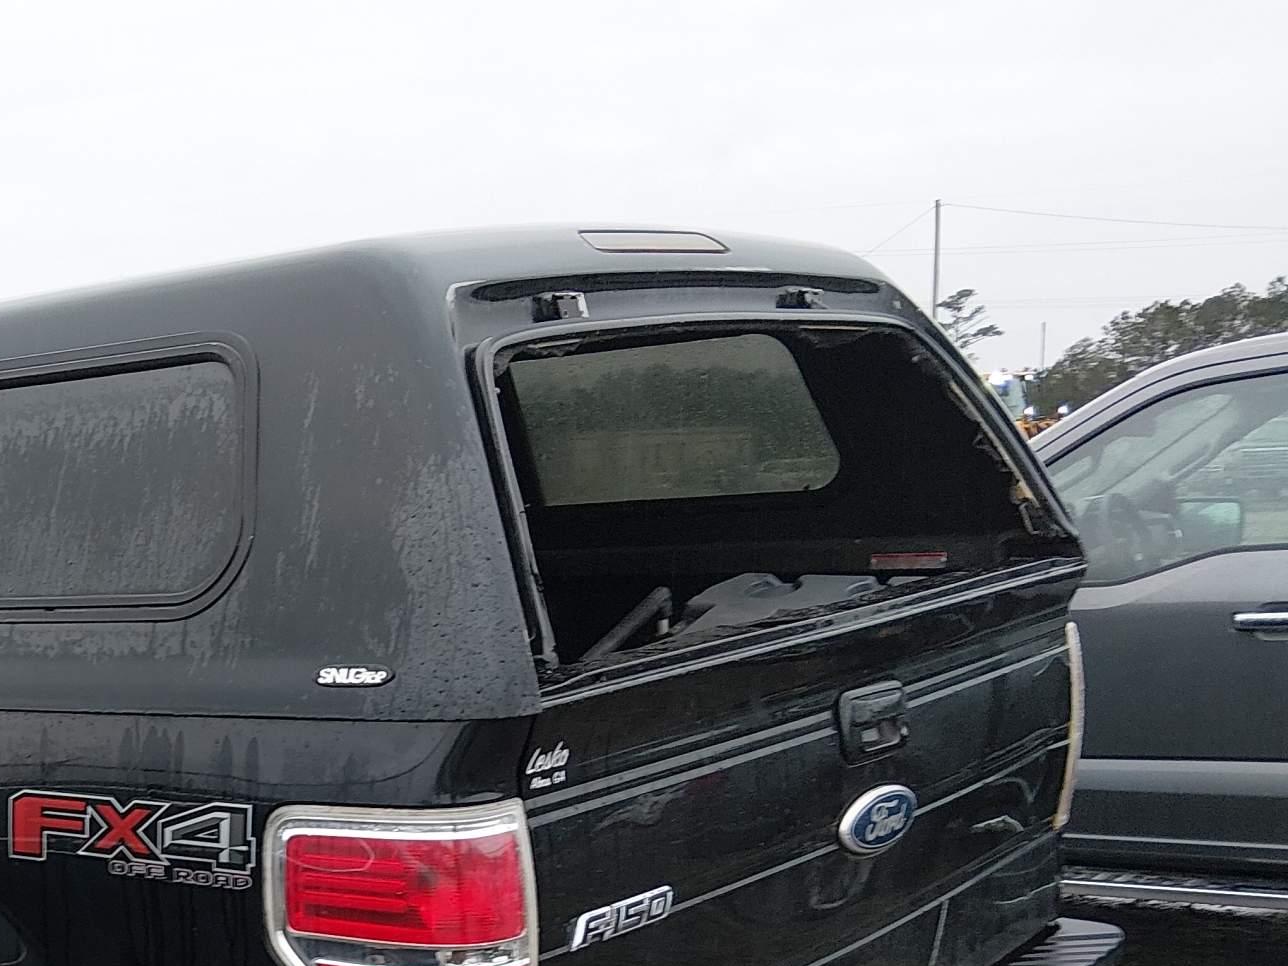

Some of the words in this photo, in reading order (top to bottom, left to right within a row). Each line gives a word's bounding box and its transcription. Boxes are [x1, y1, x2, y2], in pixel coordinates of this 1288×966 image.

[8, 788, 257, 874] FX4
[864, 799, 908, 842] Ford
[108, 860, 167, 880] OFF
[172, 867, 253, 890] ROAD
